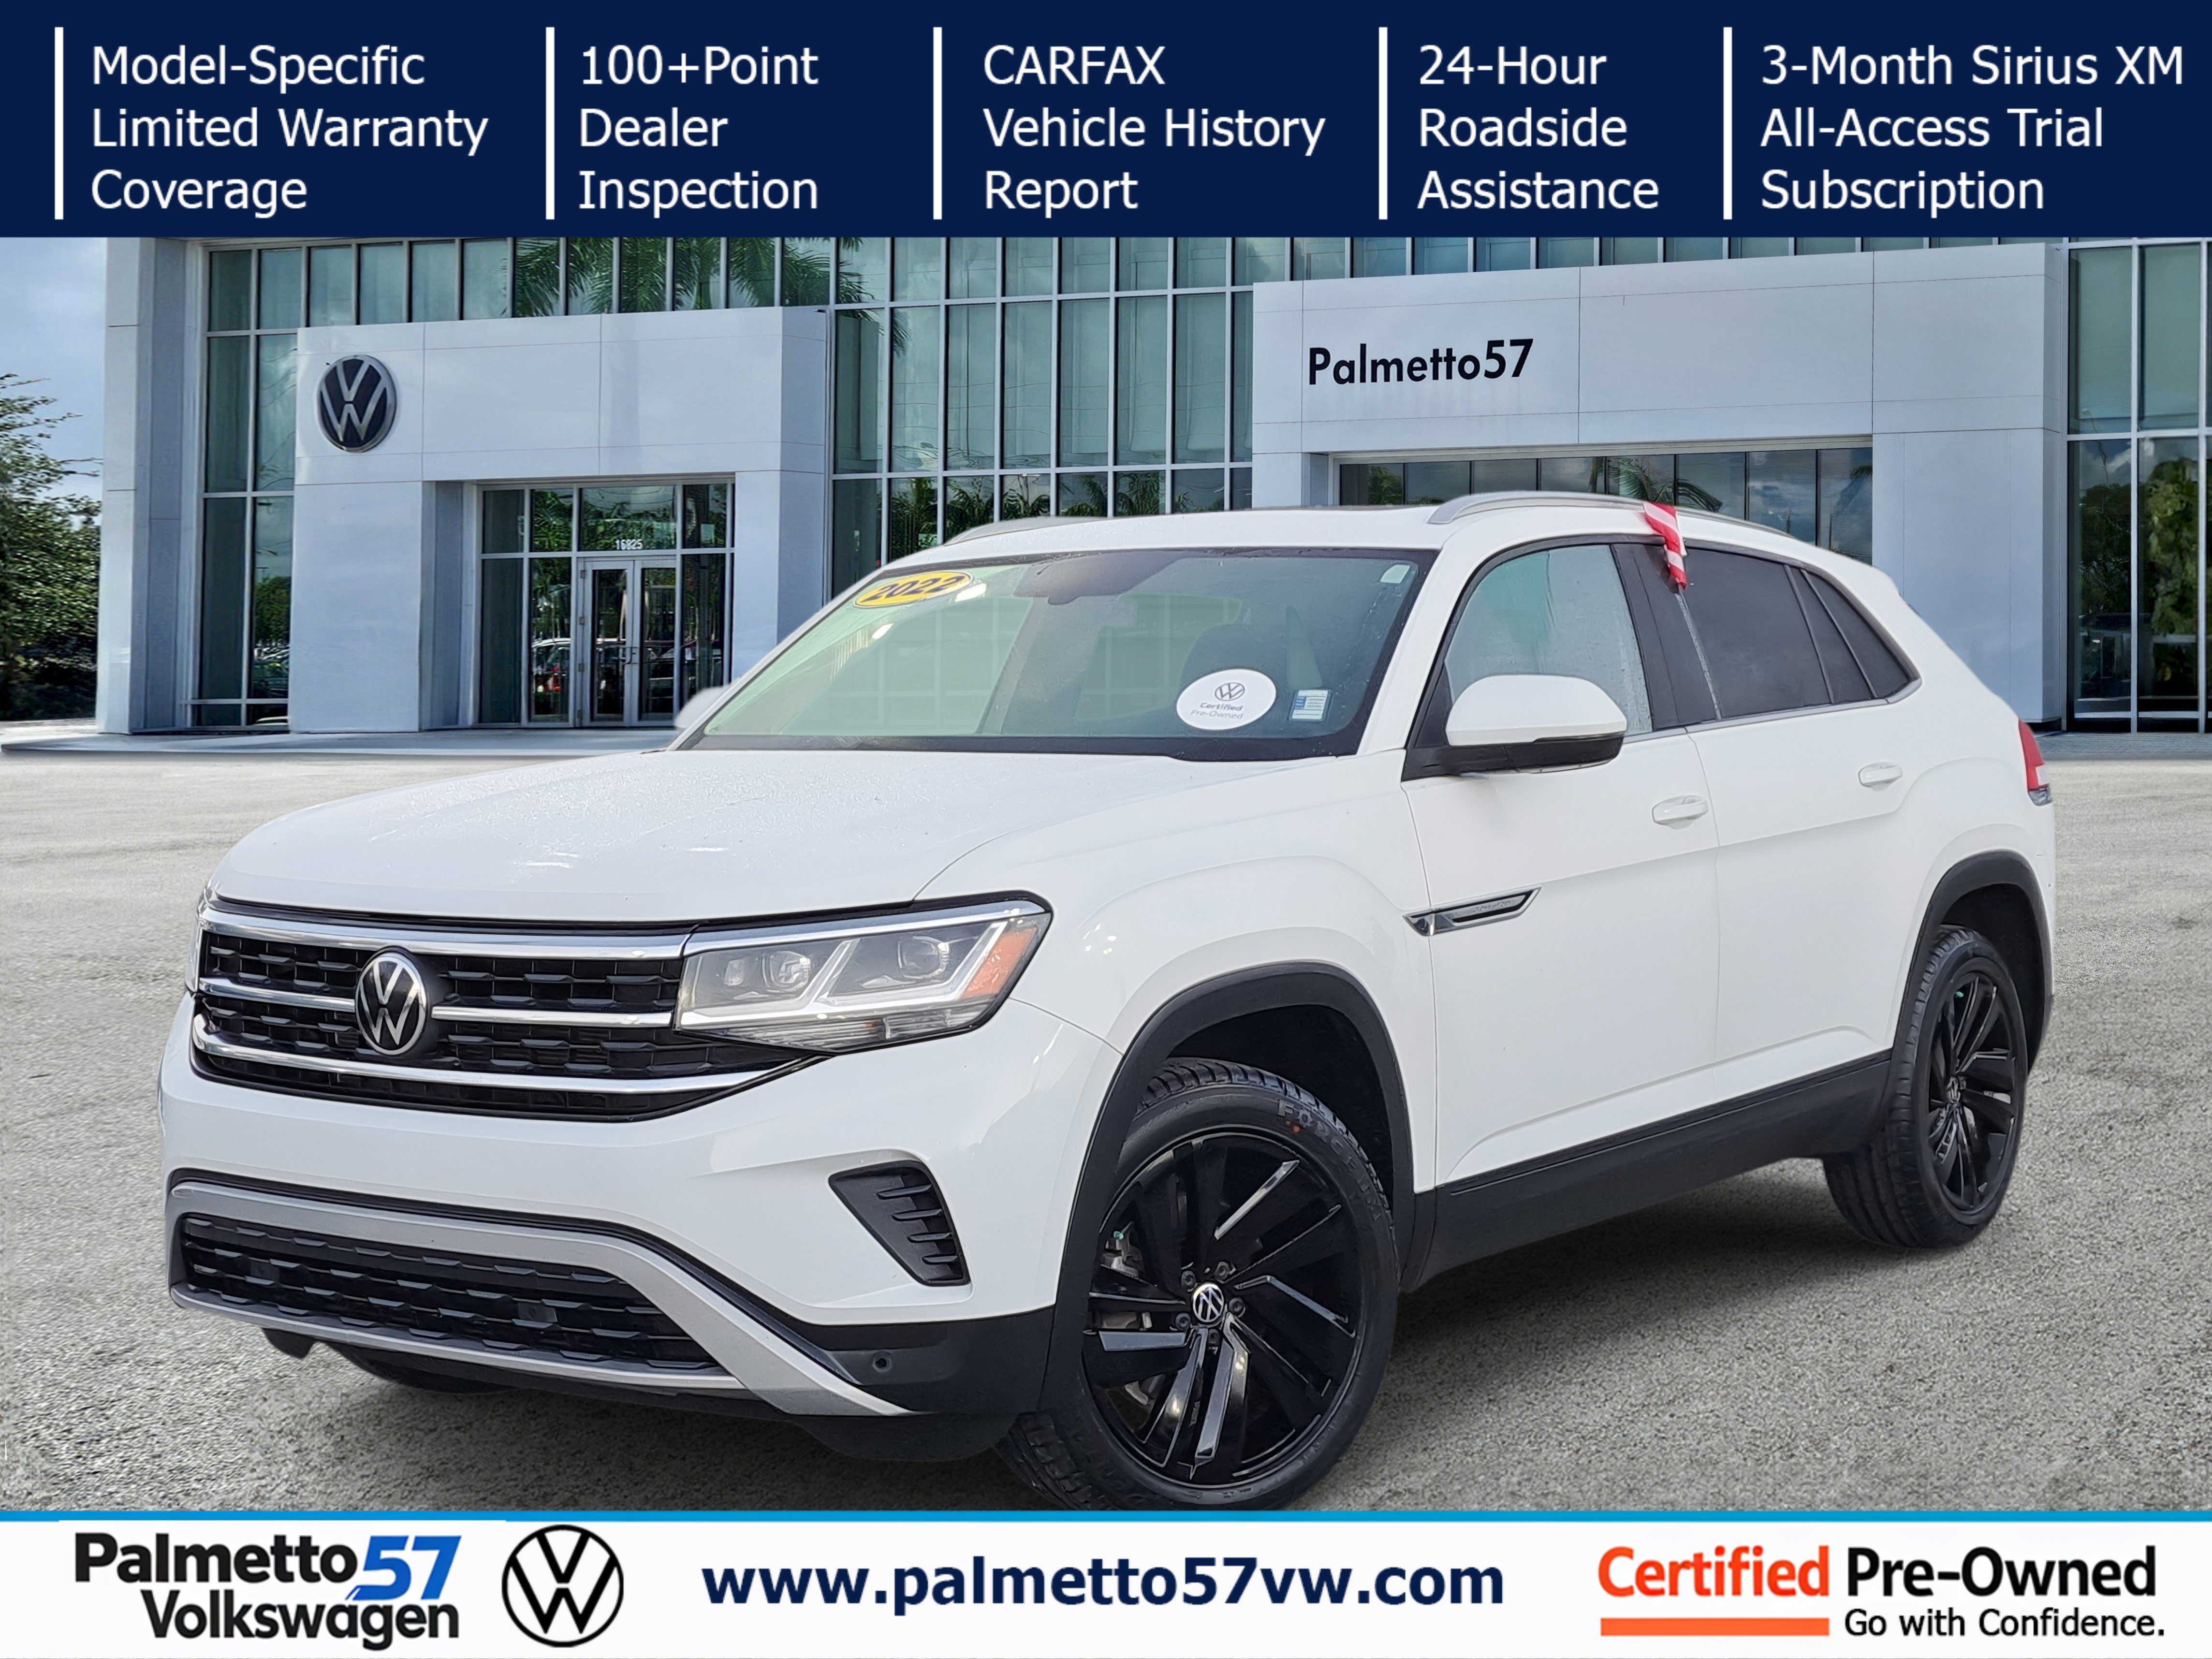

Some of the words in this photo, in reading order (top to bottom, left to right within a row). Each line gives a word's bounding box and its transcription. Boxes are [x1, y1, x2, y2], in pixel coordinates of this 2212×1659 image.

[1309, 338, 1534, 385] Palmetto57
[859, 575, 966, 603] 2022
[1200, 703, 1244, 711] Certified
